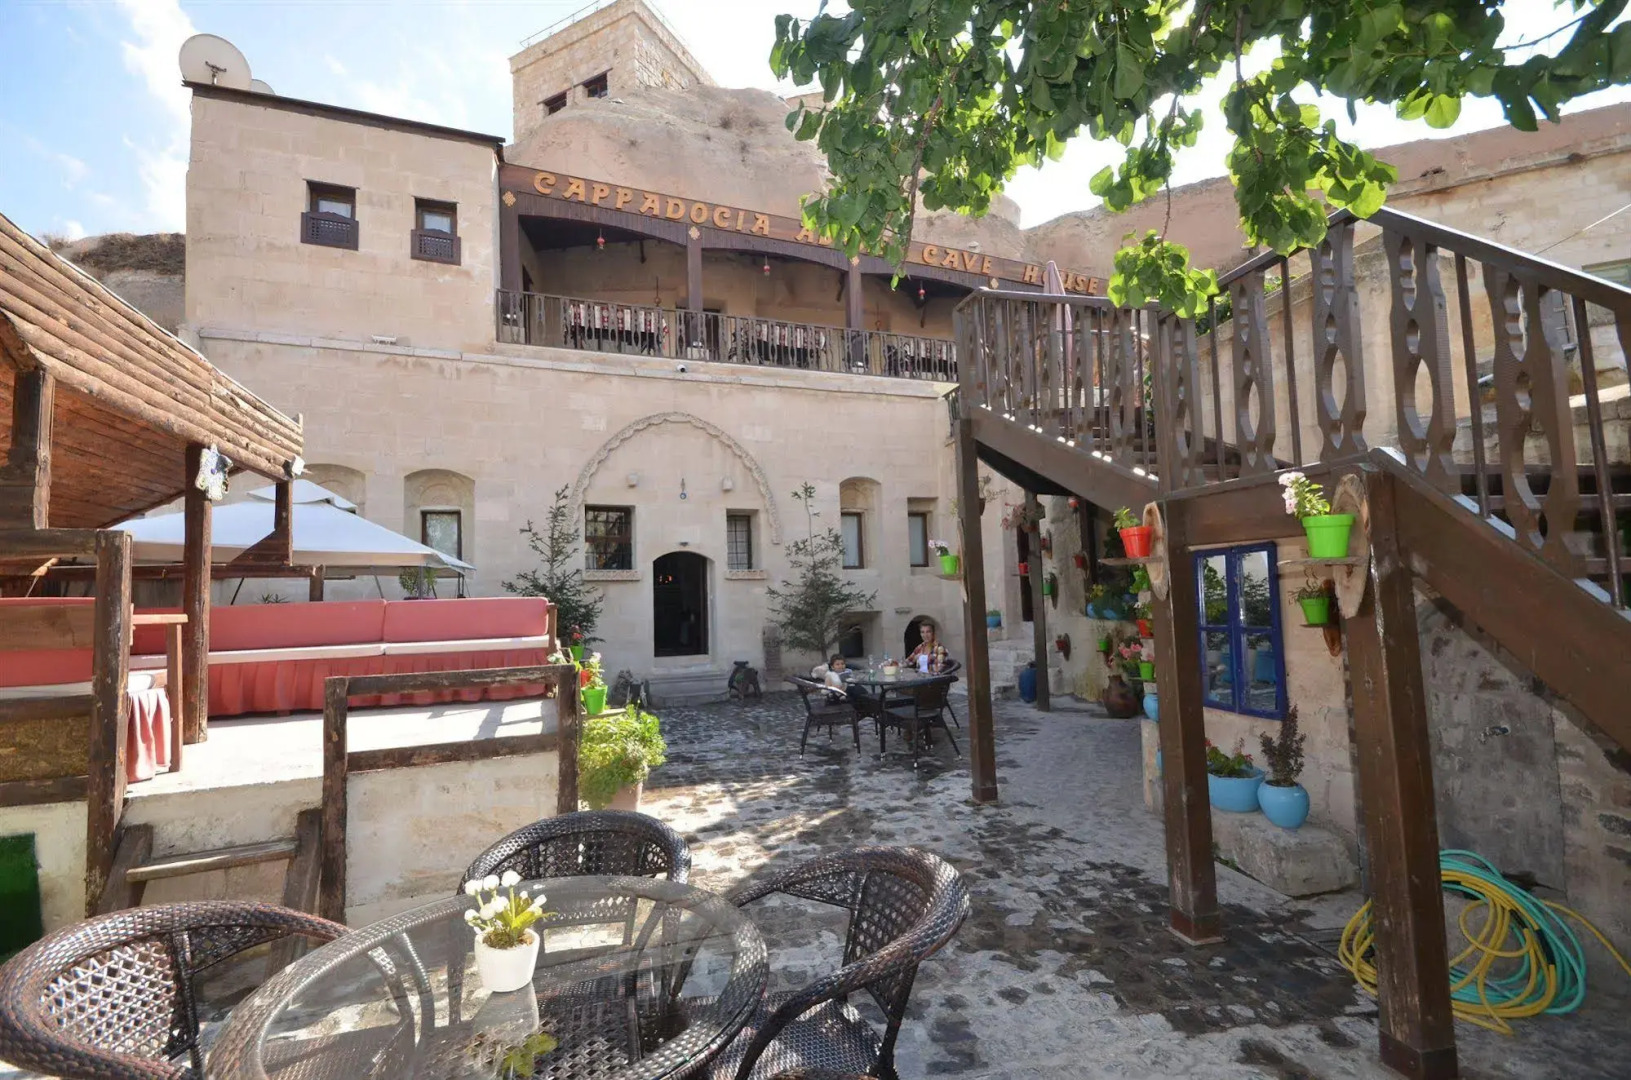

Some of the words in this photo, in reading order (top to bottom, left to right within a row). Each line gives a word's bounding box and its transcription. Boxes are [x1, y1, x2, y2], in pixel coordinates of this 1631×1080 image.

[533, 172, 770, 236] CAPPADOCIA
[922, 245, 992, 275] CAVE
[1022, 264, 1098, 295] HUSE
